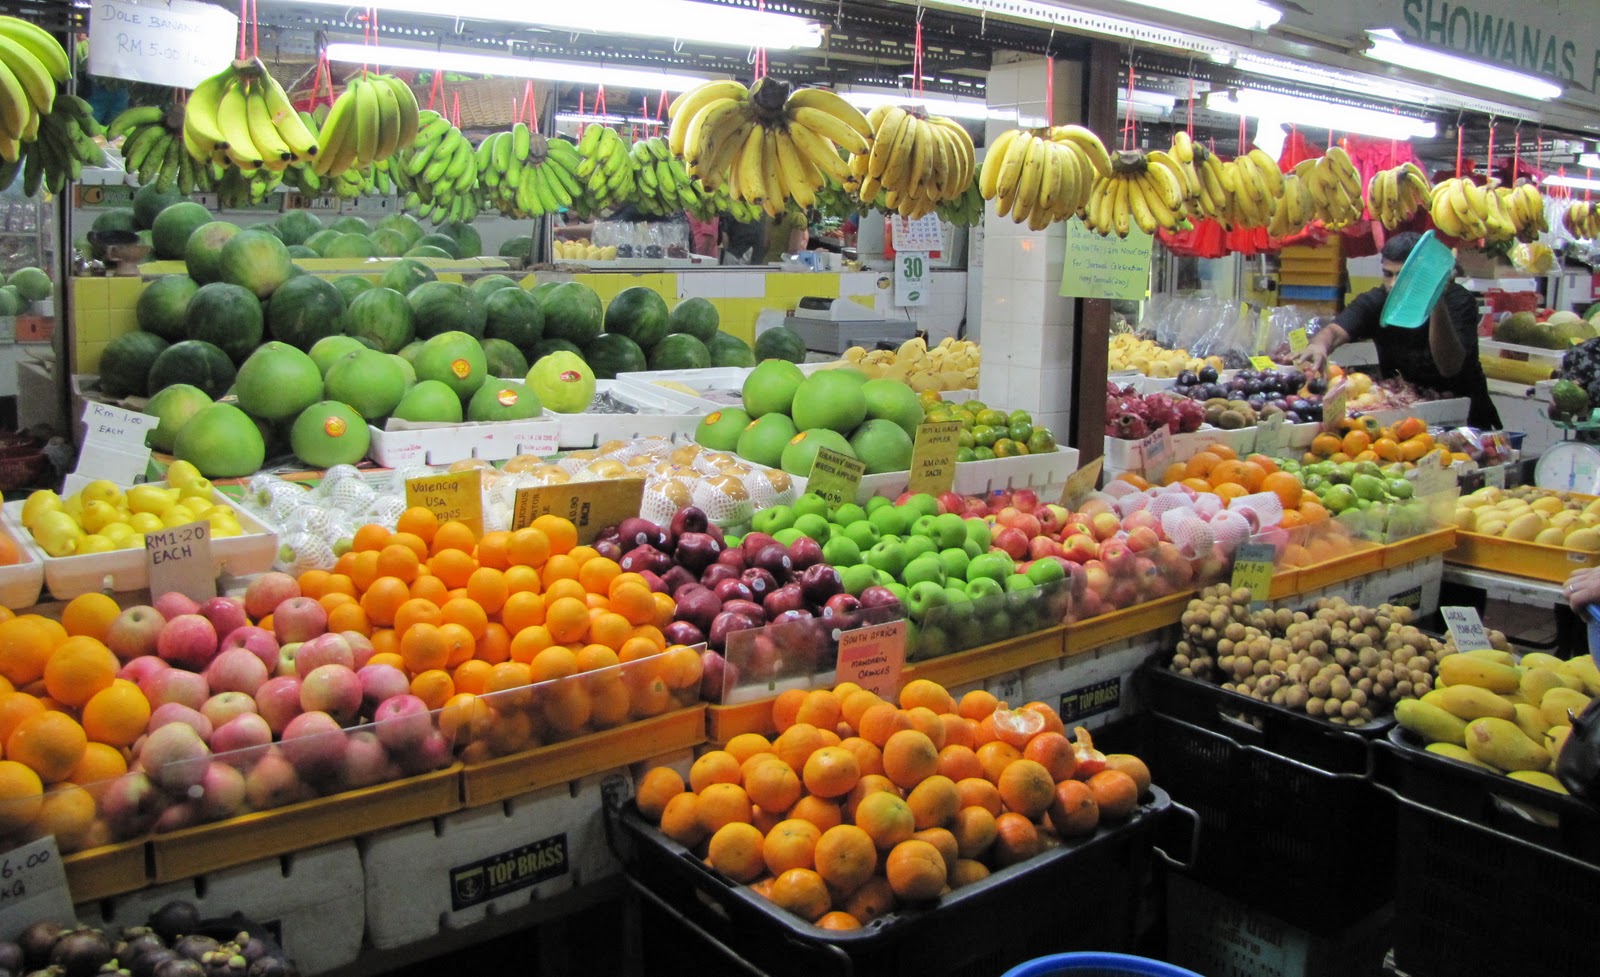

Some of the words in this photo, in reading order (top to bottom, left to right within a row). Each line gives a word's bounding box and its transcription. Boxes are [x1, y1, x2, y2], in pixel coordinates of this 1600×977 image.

[101, 4, 141, 24] DOLE
[117, 33, 142, 56] RM
[1403, 0, 1576, 81] SHOWANAS
[904, 257, 923, 278] 30
[124, 414, 143, 424] 1.00
[99, 425, 124, 435] EACH
[815, 462, 836, 474] GREEN
[836, 470, 858, 483] APPLES
[819, 451, 846, 466] GRANNY
[844, 461, 862, 473] SMITH
[925, 469, 942, 477] EACH
[425, 497, 447, 507] USA
[518, 492, 529, 529] ELICIOUS
[530, 493, 540, 524] NGTON
[435, 508, 461, 521] nges
[580, 502, 591, 526] EACH
[153, 544, 192, 565] EACH
[843, 633, 868, 646] SOUTH
[870, 626, 897, 640] AFRICA
[851, 651, 888, 668] MANDARIN
[1079, 692, 1094, 711] TOP
[1094, 684, 1119, 706] BRASS
[487, 859, 517, 887] TOP
[517, 843, 564, 878] BRASS
